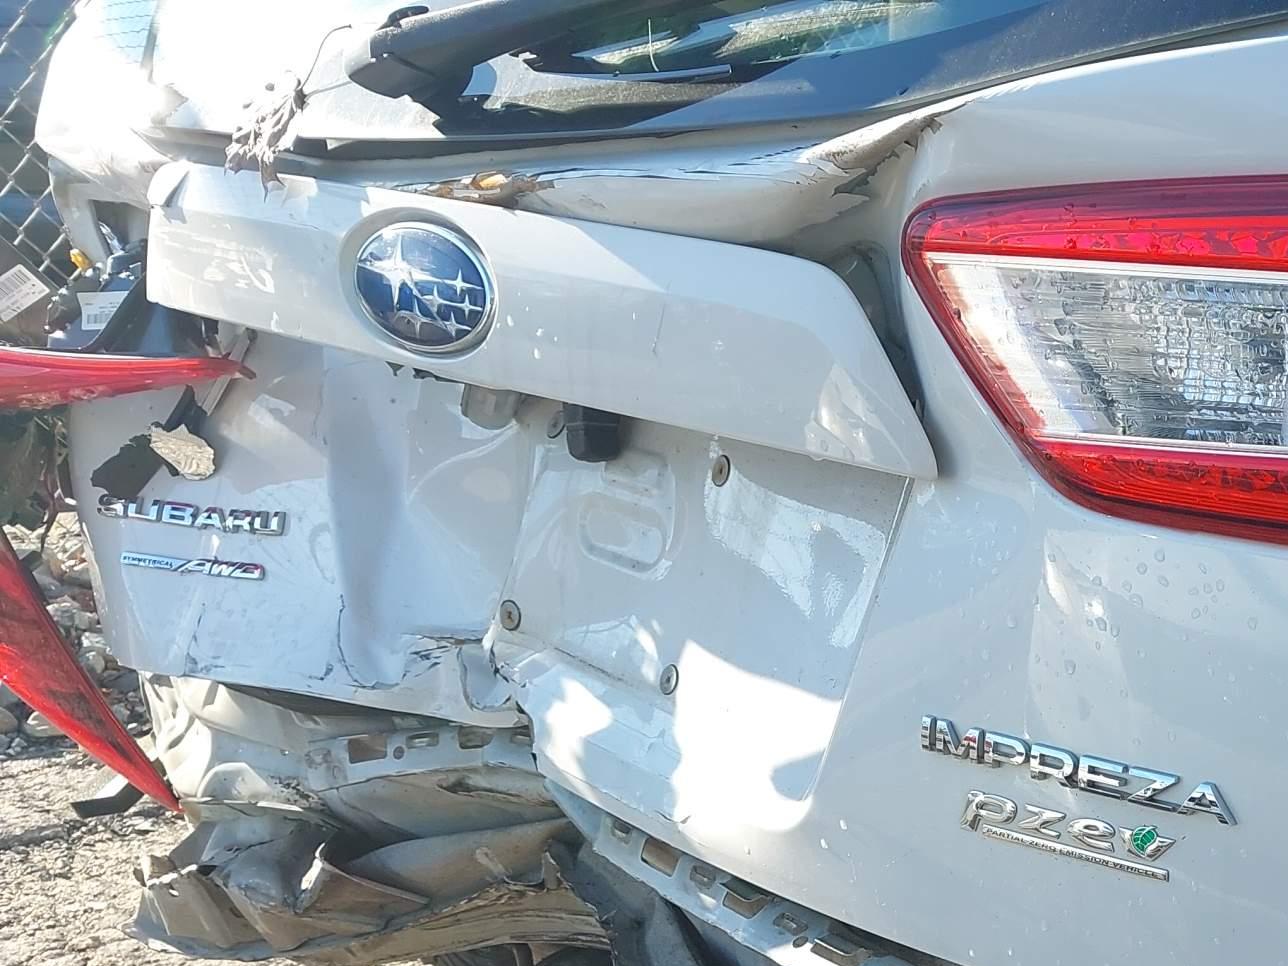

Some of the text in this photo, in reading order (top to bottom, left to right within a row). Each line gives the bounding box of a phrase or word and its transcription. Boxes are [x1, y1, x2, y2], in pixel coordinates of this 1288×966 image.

[97, 494, 287, 536] SUBARU
[176, 558, 266, 580] AWD
[920, 714, 1238, 826] IMPREZA
[986, 828, 1024, 842] PARTIAL
[1028, 840, 1057, 853] ZERO
[1059, 848, 1109, 867] EMISSION
